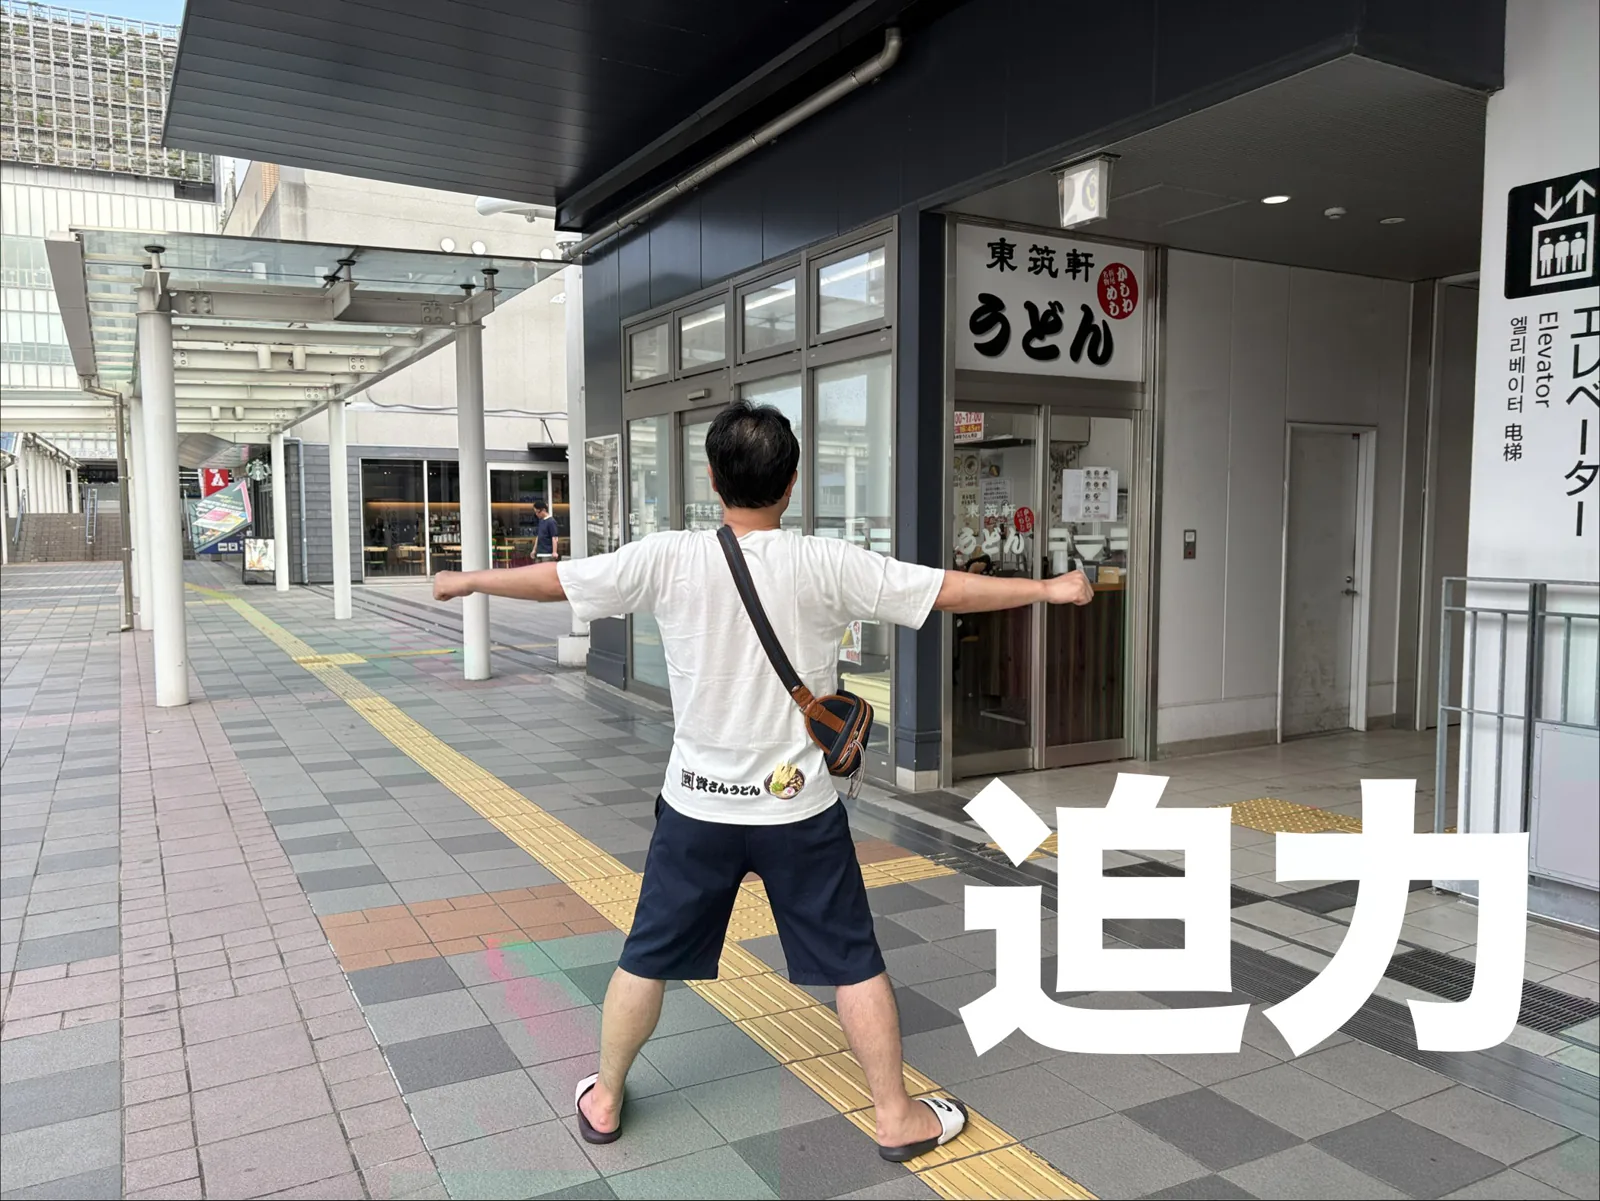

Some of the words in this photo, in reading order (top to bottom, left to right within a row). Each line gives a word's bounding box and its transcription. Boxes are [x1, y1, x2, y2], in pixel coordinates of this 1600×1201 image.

[986, 237, 1095, 282] 東筑軒
[1106, 285, 1120, 317] めし
[1116, 266, 1133, 314] かしわ
[969, 292, 1114, 367] うどん
[1508, 315, 1527, 413] 엘리베이터
[1535, 311, 1559, 408] Elevator
[1502, 422, 1523, 462] 电梯
[1563, 304, 1600, 537] エレベーター
[966, 502, 1016, 518] 東筑軒
[959, 526, 1025, 555] うどん
[695, 776, 761, 796] 資さんうどん
